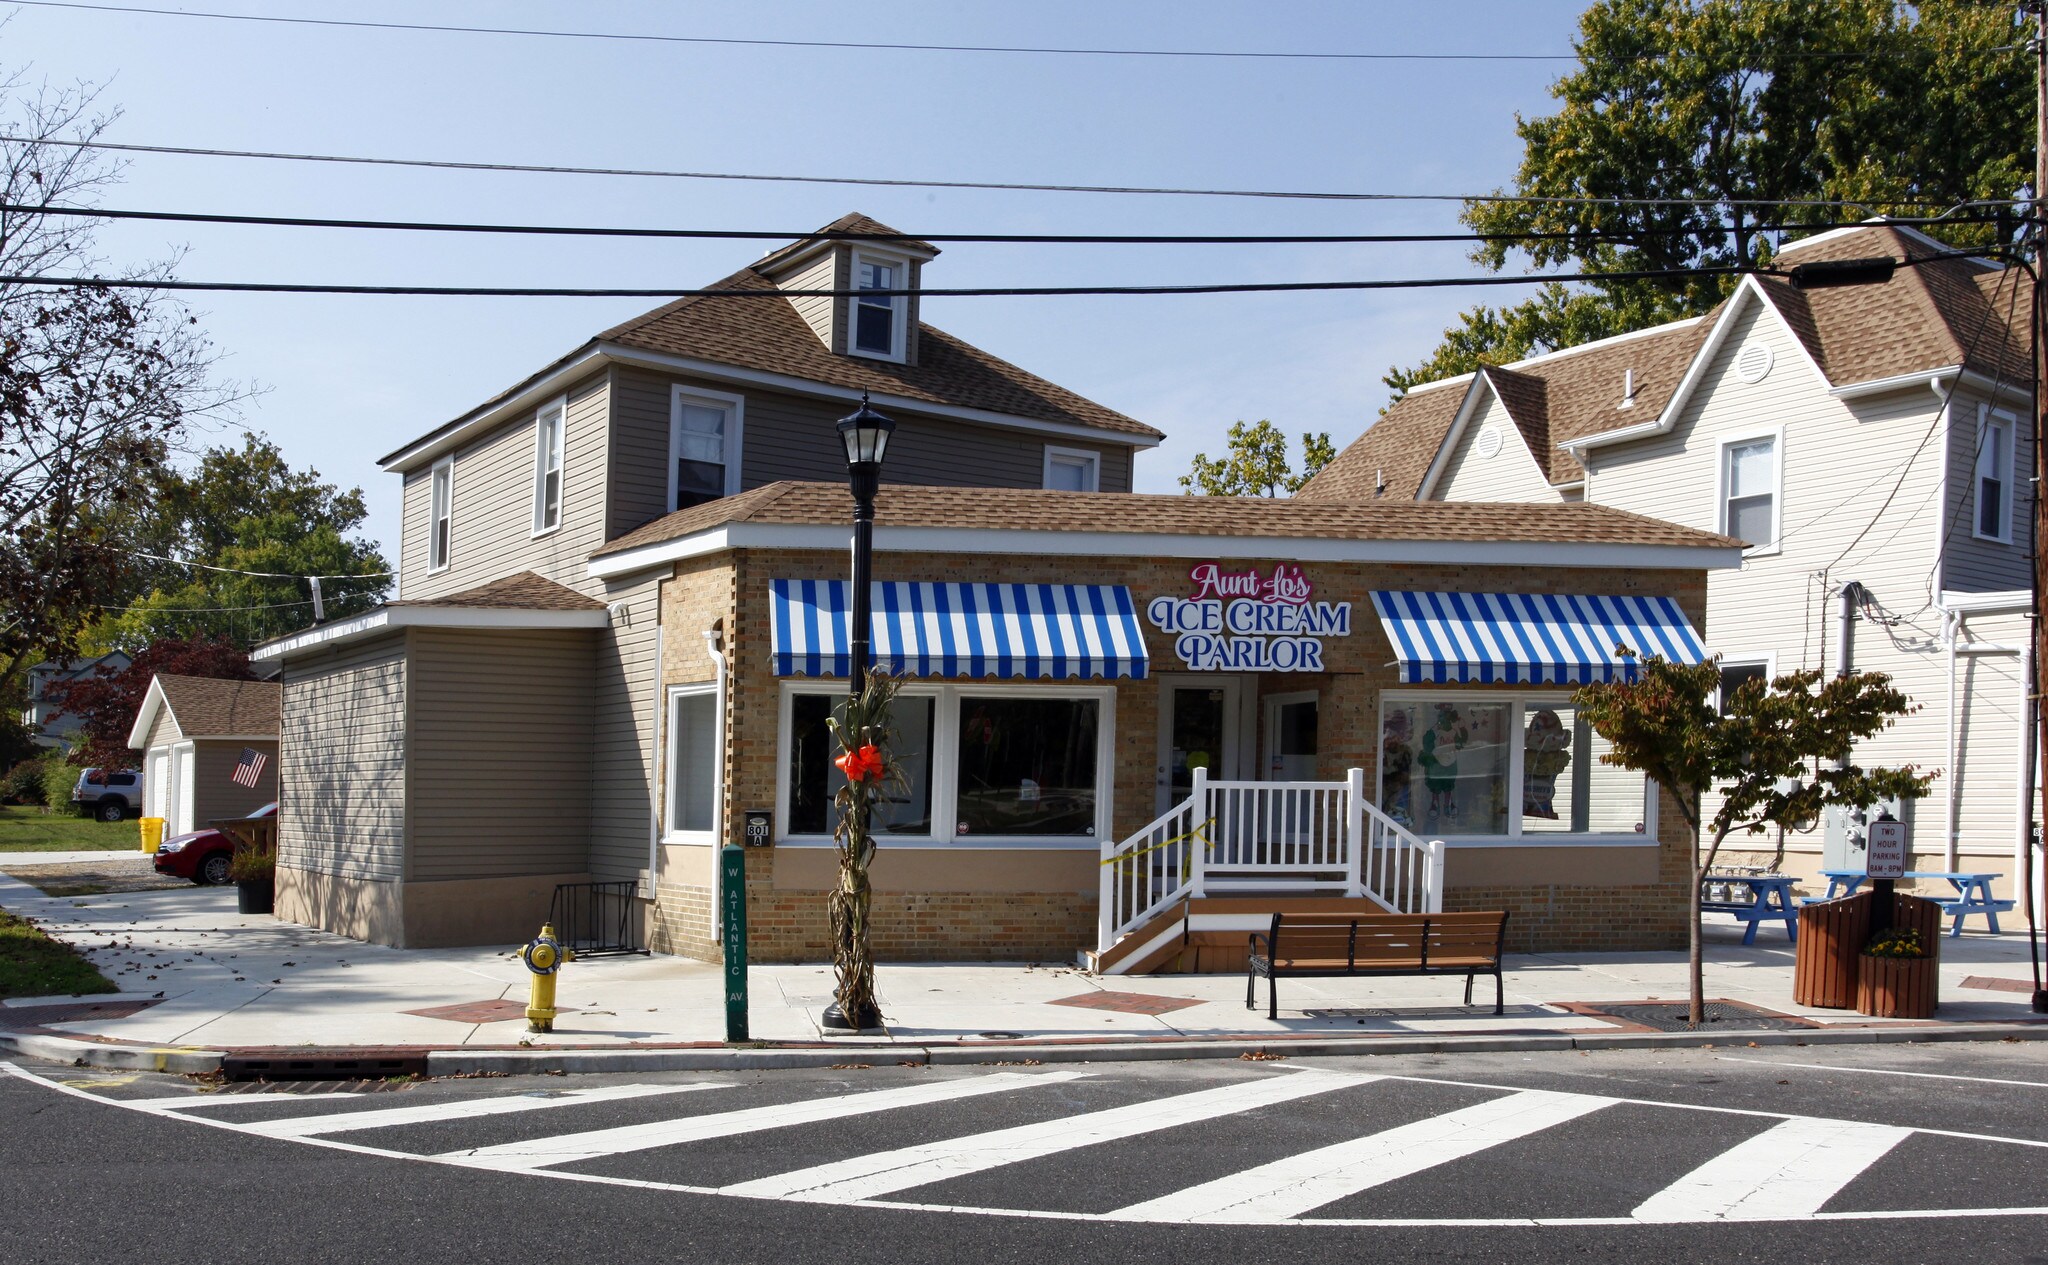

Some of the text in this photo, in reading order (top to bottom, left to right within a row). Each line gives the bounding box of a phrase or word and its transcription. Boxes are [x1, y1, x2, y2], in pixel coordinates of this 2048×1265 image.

[1191, 564, 1310, 601] Aunt Lo's
[1151, 601, 1348, 632] ICE CREAM
[1178, 635, 1320, 668] PARLOR
[748, 826, 767, 835] 801
[1881, 828, 1895, 836] TWO
[754, 836, 761, 846] A
[1877, 840, 1897, 848] HOUR
[1872, 852, 1900, 860] PARKING
[728, 868, 743, 1001] W ATLANTIC AV
